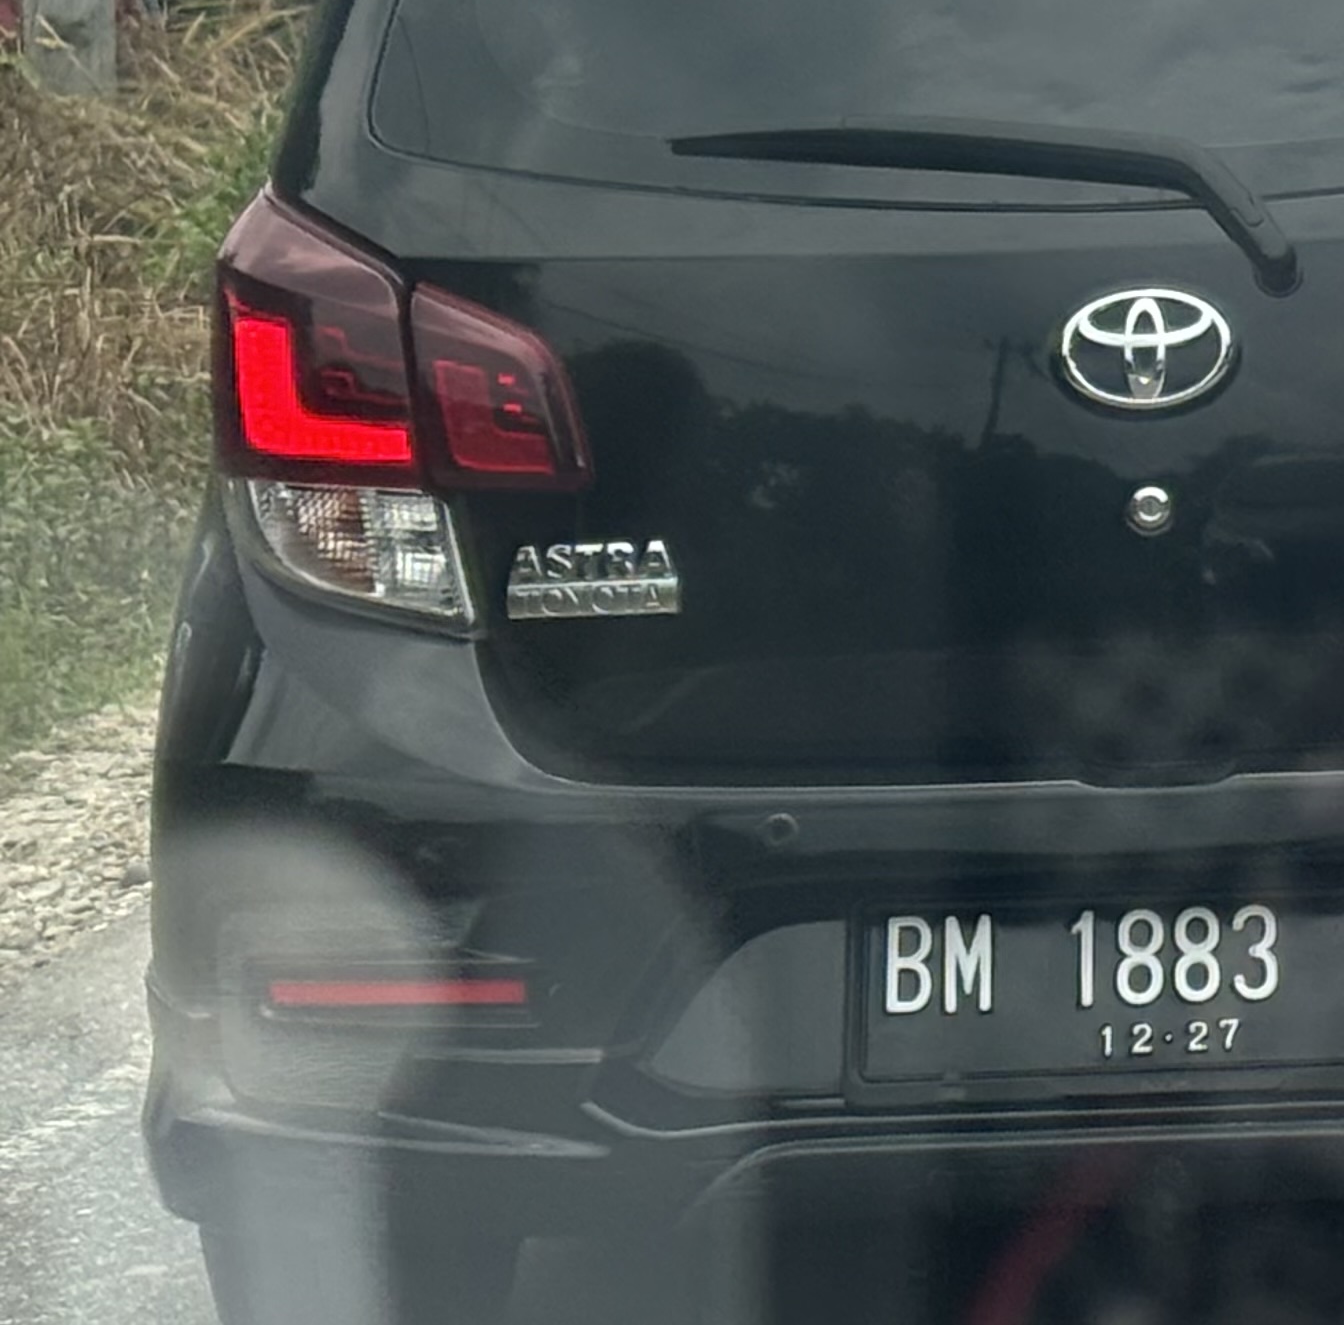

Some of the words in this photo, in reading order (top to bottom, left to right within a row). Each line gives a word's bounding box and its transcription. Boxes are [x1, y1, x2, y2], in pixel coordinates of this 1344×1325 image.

[511, 540, 673, 578] ASTRA
[513, 584, 664, 615] TOYOTA
[885, 914, 993, 1014] BM
[1070, 904, 1280, 1008] 1883
